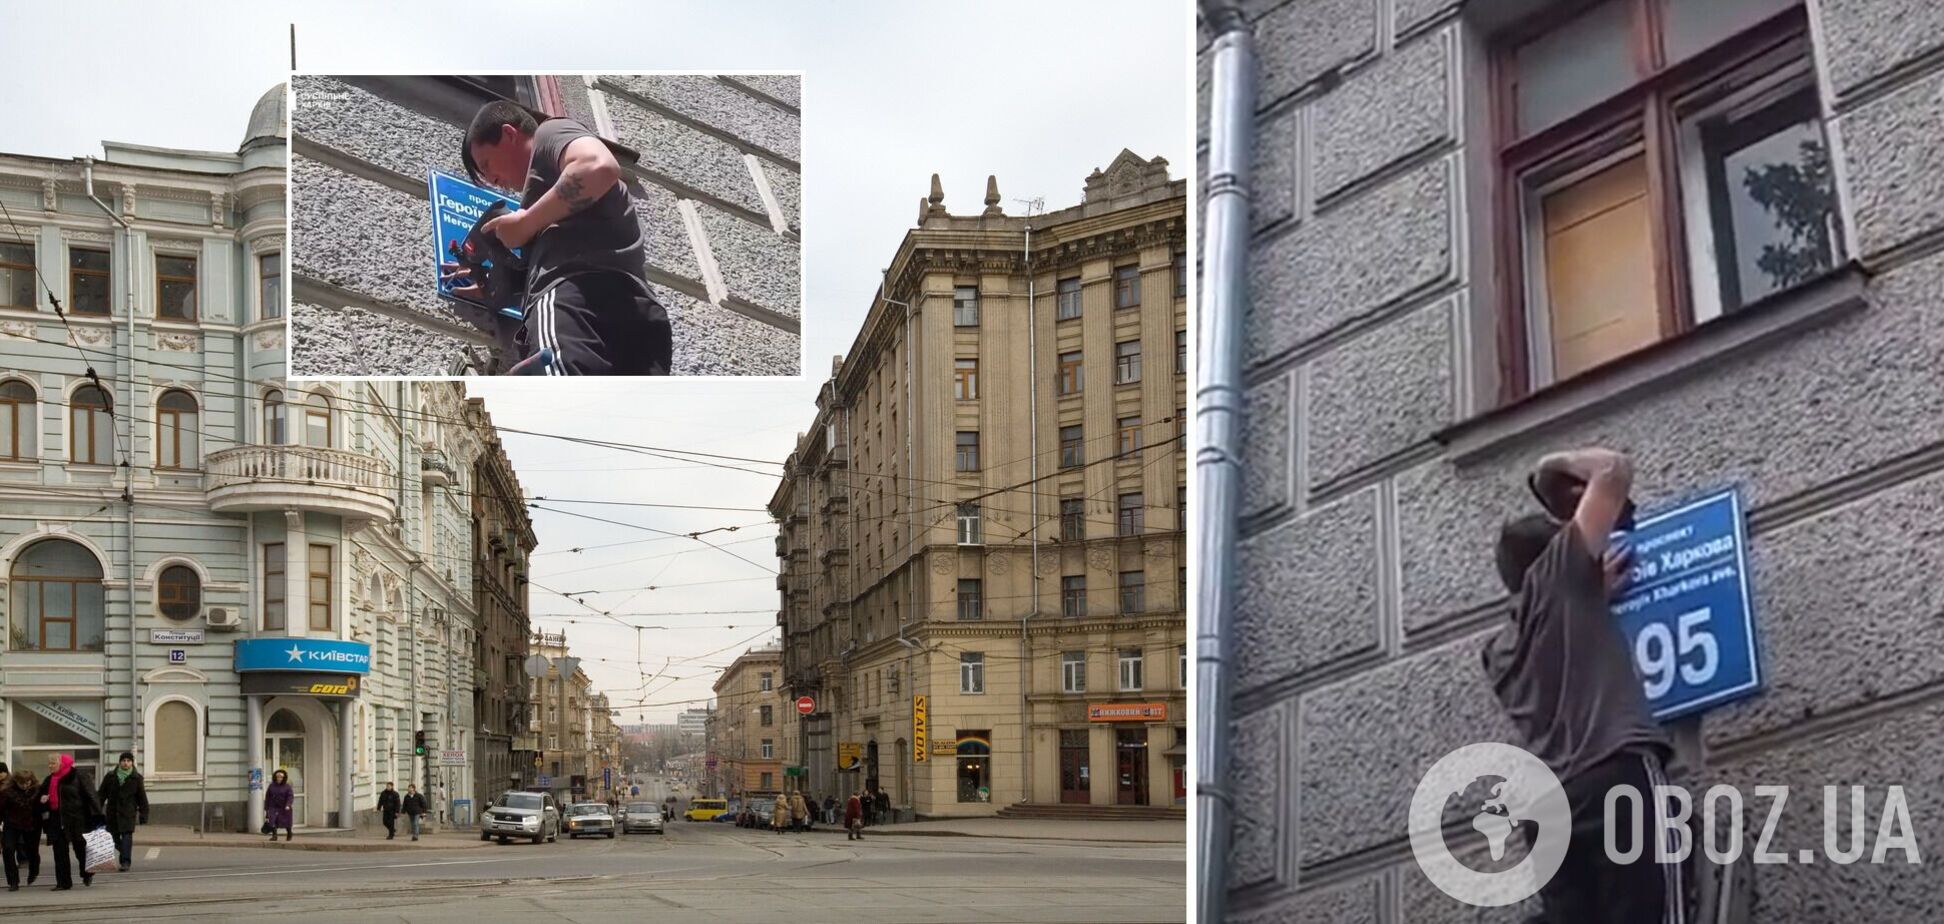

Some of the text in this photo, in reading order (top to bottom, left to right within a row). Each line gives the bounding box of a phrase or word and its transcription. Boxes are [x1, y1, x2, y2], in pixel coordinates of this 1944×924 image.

[1660, 534, 1734, 574] Харкова
[154, 633, 201, 642] Конституції
[172, 652, 184, 660] 12
[308, 650, 369, 664] КИЇВСТАР
[1635, 606, 1719, 700] 95
[915, 696, 925, 762] SLALOM
